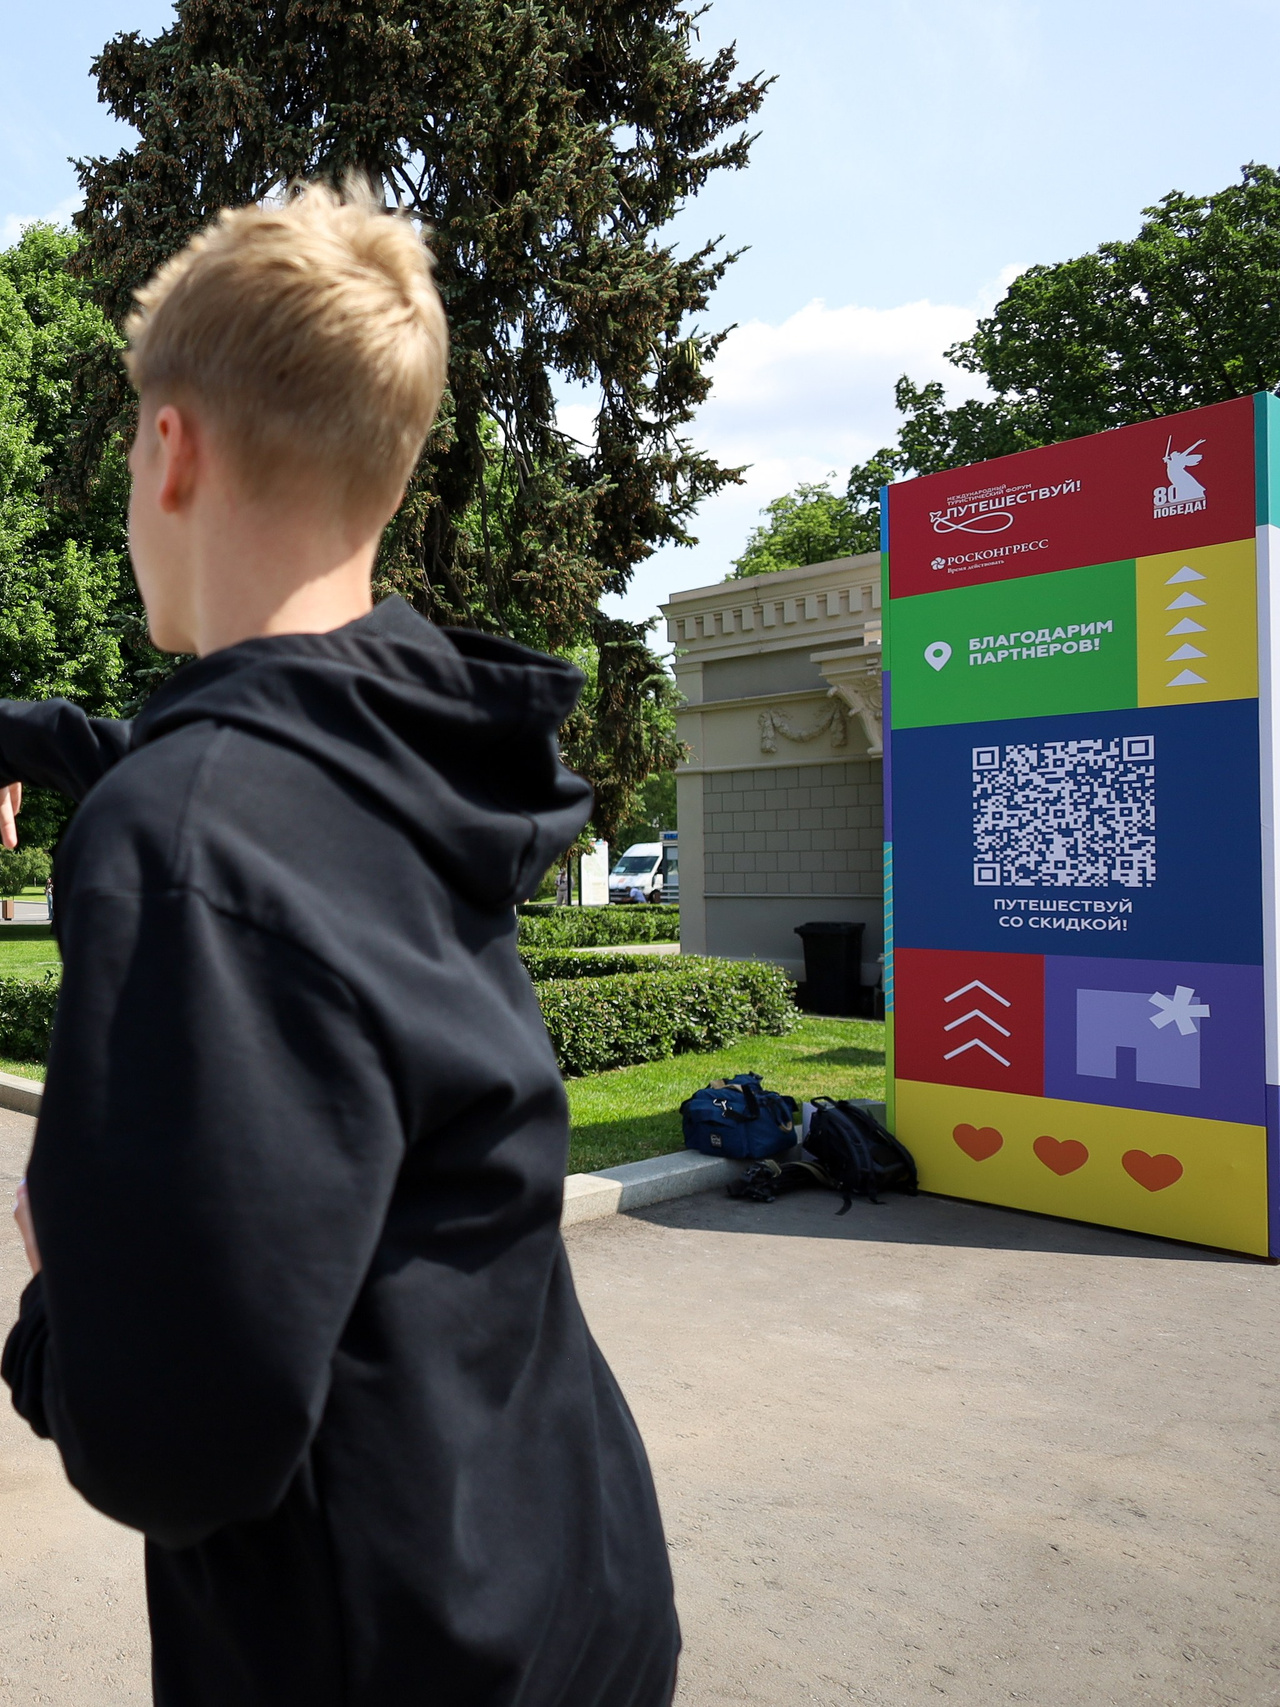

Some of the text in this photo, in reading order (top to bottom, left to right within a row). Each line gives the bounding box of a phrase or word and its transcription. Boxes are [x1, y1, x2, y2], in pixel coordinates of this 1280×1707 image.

[946, 484, 1007, 502] МЕЖДУНАРОДНЫЙ
[946, 483, 1032, 506] ТУРИСТИЧЕСКИЙ ФОРУМ
[946, 478, 1082, 519] ПУТЕШЕСТВУЙ!
[1153, 486, 1178, 506] 80
[1153, 499, 1207, 519] ПОБЕДА!
[947, 538, 1049, 566] РОСКОНГРЕСС
[969, 619, 1113, 651] БЛАГОДАРИМ
[969, 638, 1100, 666] ПАРТНЕРОВ!
[993, 898, 1133, 913] ПУТЕШЕСТВУЙ
[998, 916, 1128, 932] СО СКИДКОЙ!
